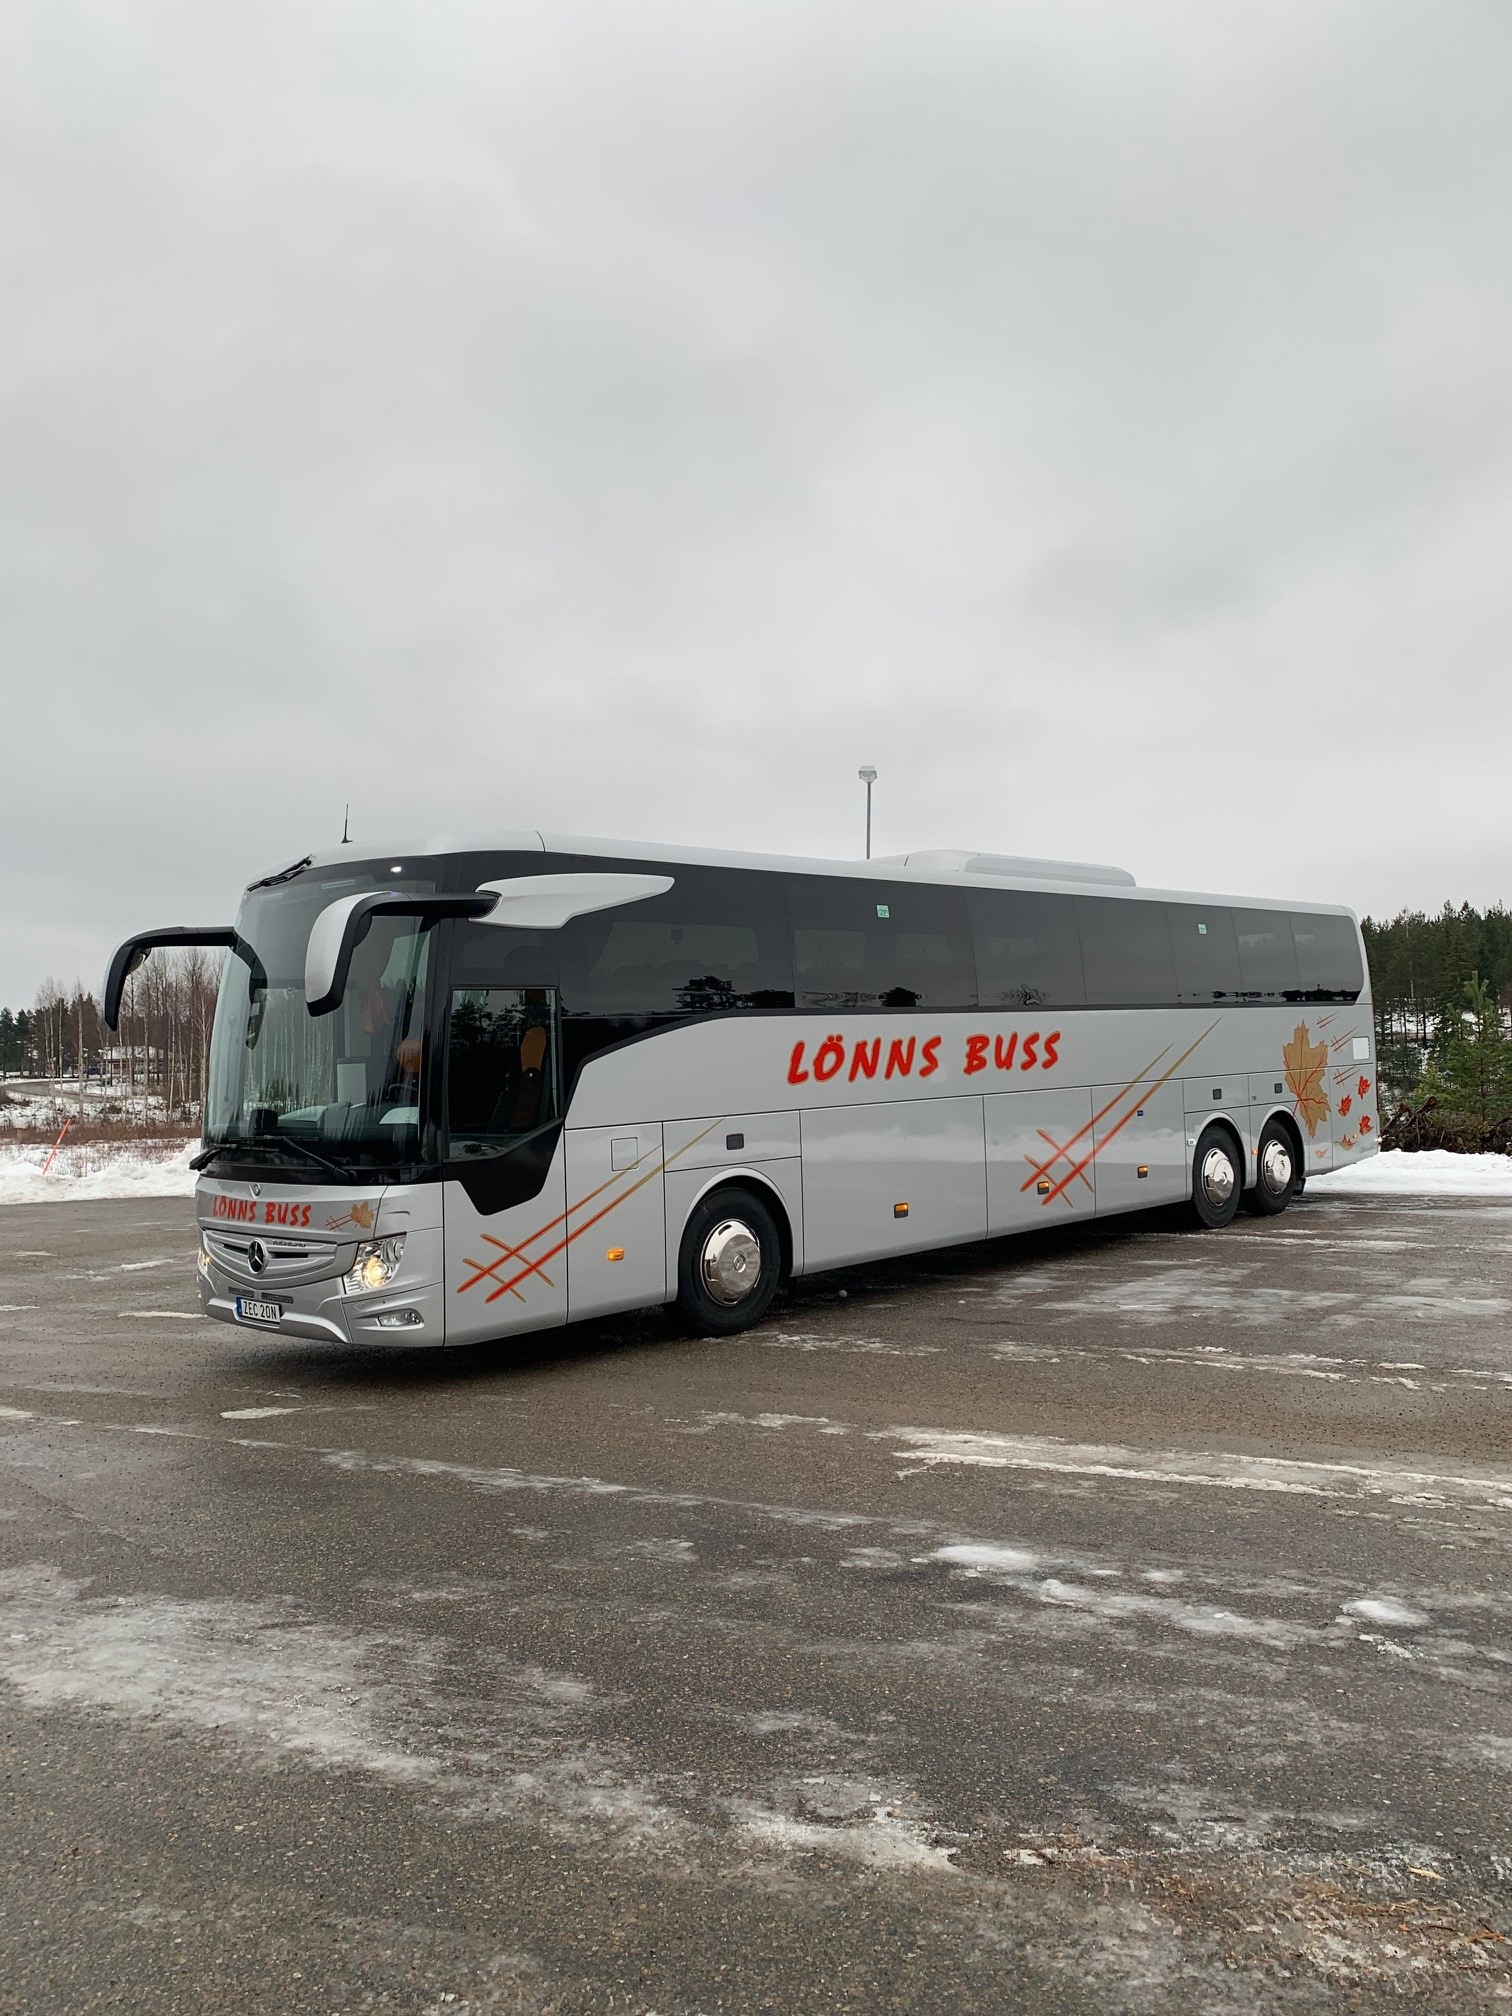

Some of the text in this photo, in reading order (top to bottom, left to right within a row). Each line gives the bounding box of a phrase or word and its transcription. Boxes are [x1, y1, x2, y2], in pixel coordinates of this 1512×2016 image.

[787, 1031, 1061, 1086] LÖNNS BUSS
[264, 1202, 312, 1227] BUSS
[243, 1301, 259, 1317] ZEC
